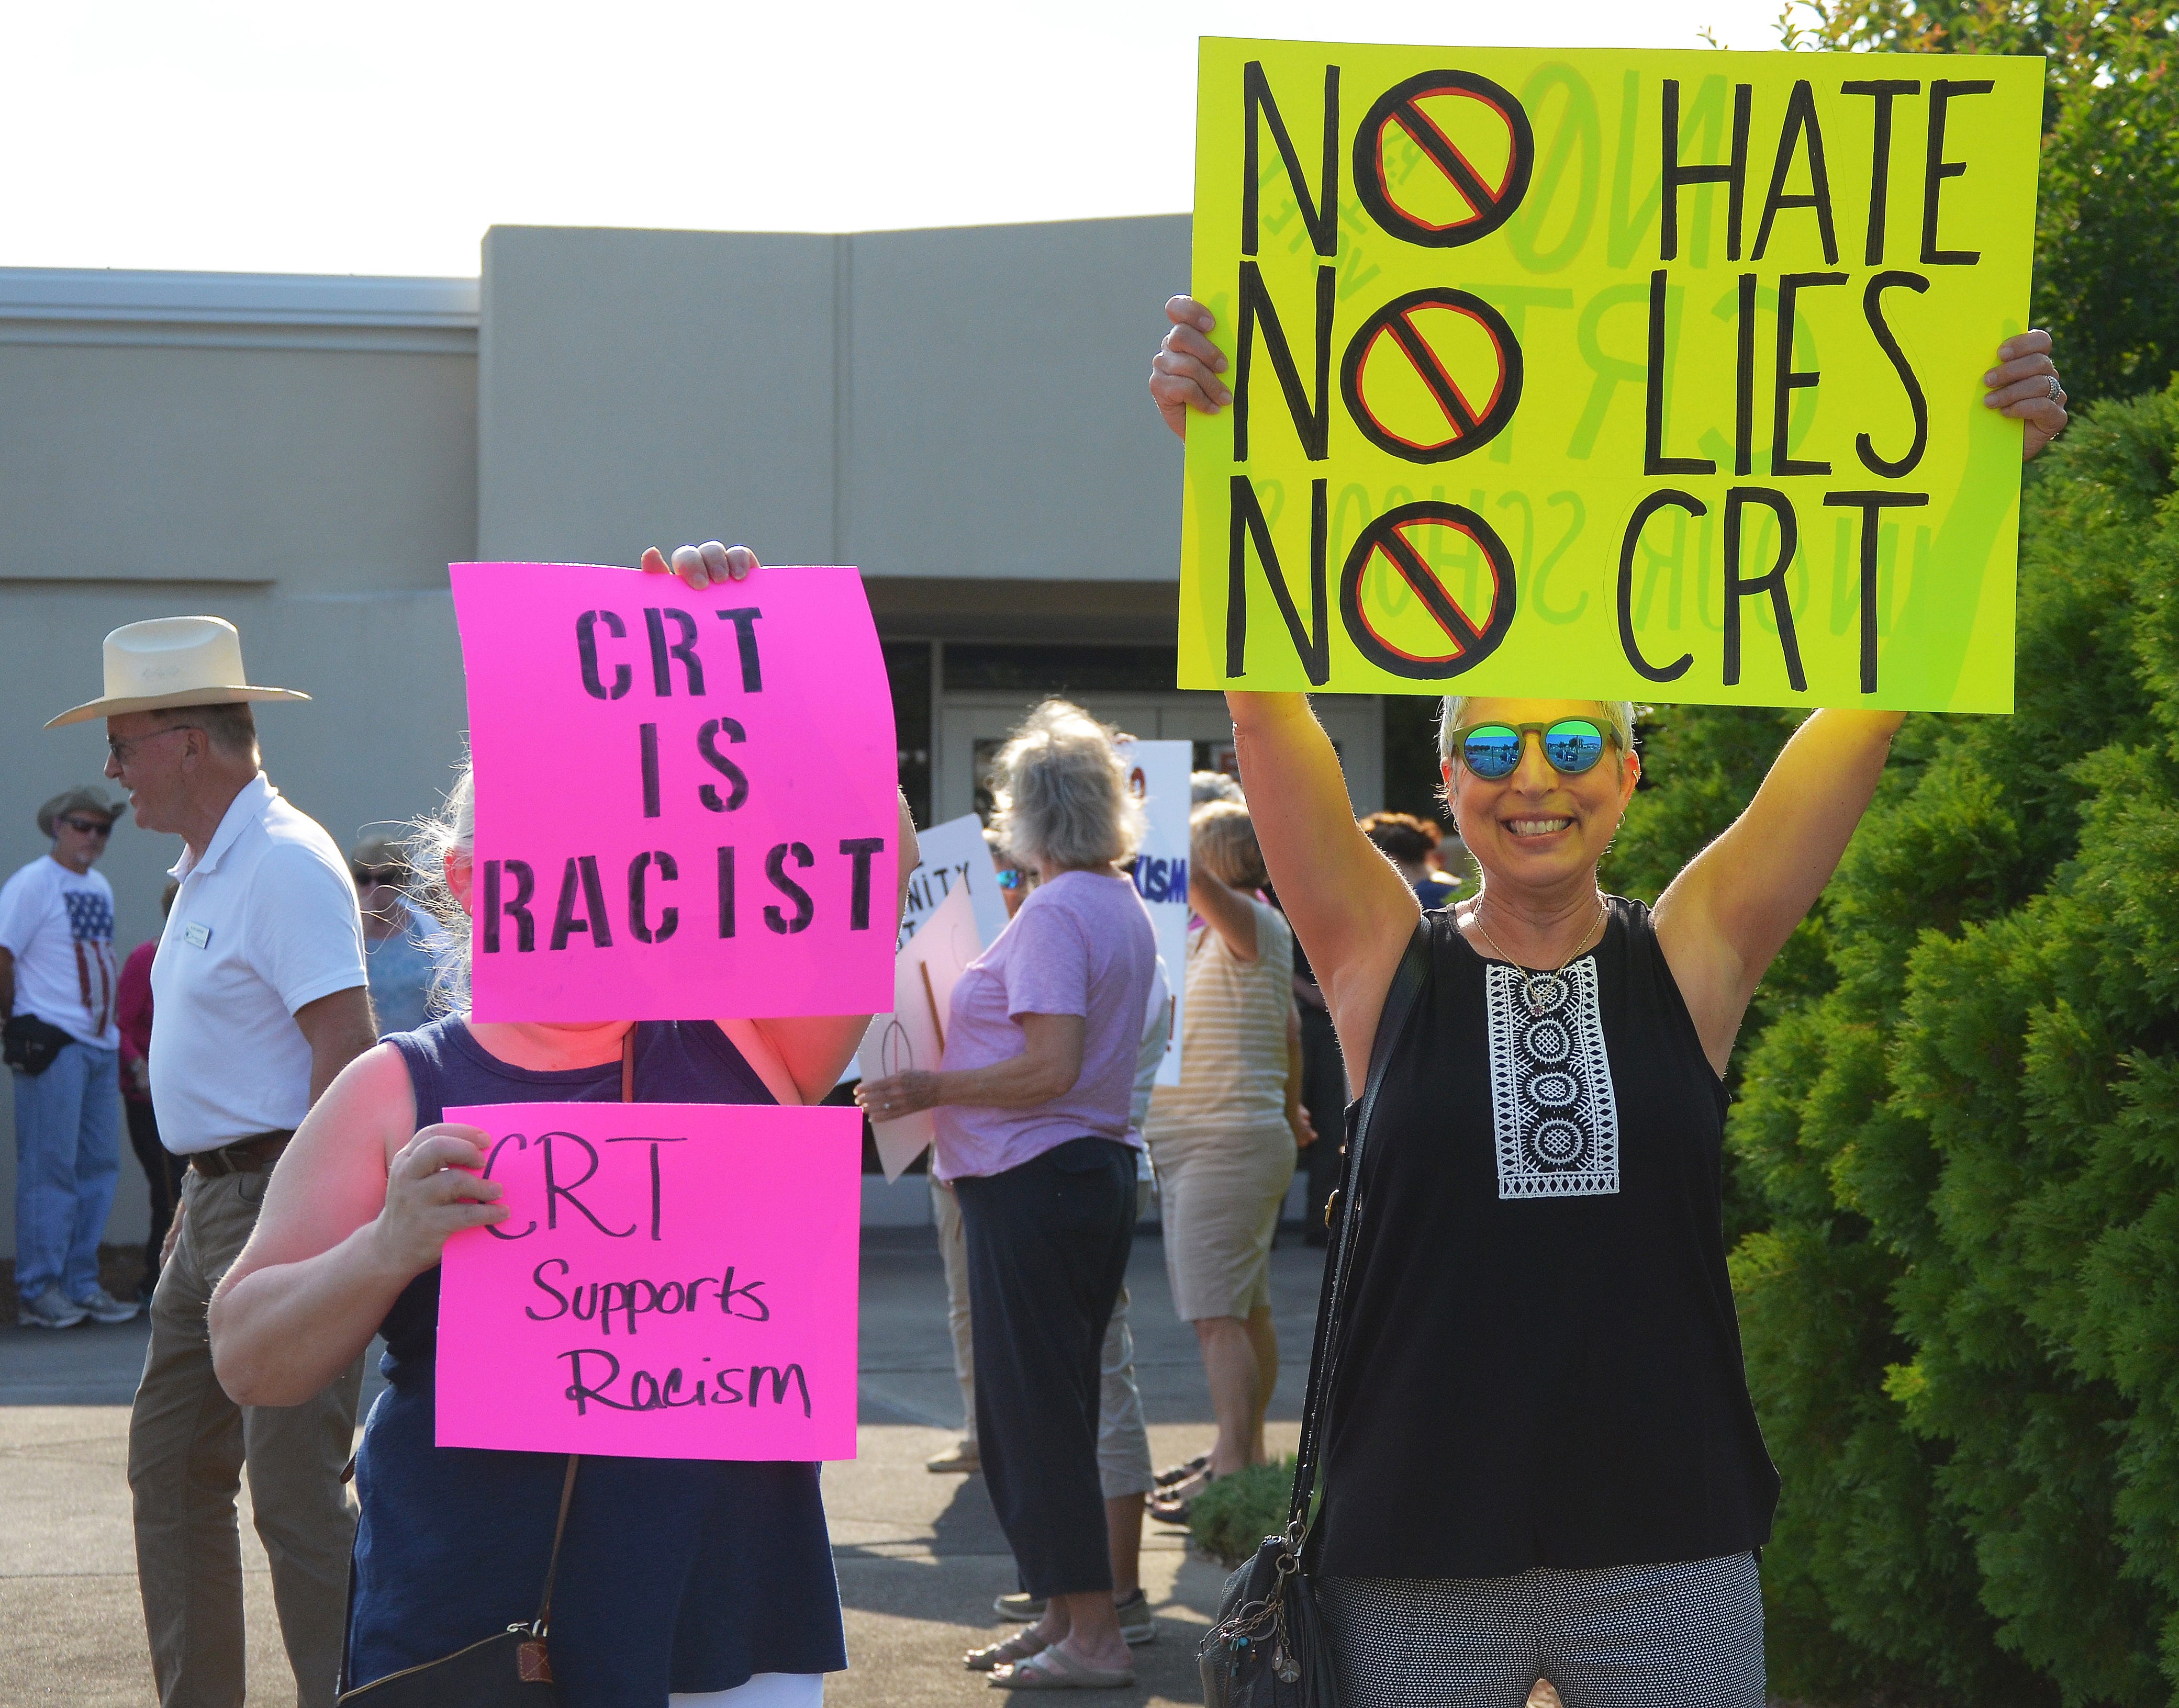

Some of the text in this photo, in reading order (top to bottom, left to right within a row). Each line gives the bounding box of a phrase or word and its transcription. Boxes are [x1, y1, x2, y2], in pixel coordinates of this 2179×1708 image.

[1242, 61, 1996, 266] NO HATE
[1233, 261, 1930, 478] NO LIES
[1226, 475, 1929, 694] NO CRT
[576, 607, 763, 700] CRT
[640, 717, 749, 818] IS
[483, 837, 884, 953] RACIST
[482, 1131, 688, 1241] CRT
[526, 1258, 769, 1335] Supports
[557, 1349, 811, 1419] Racism
